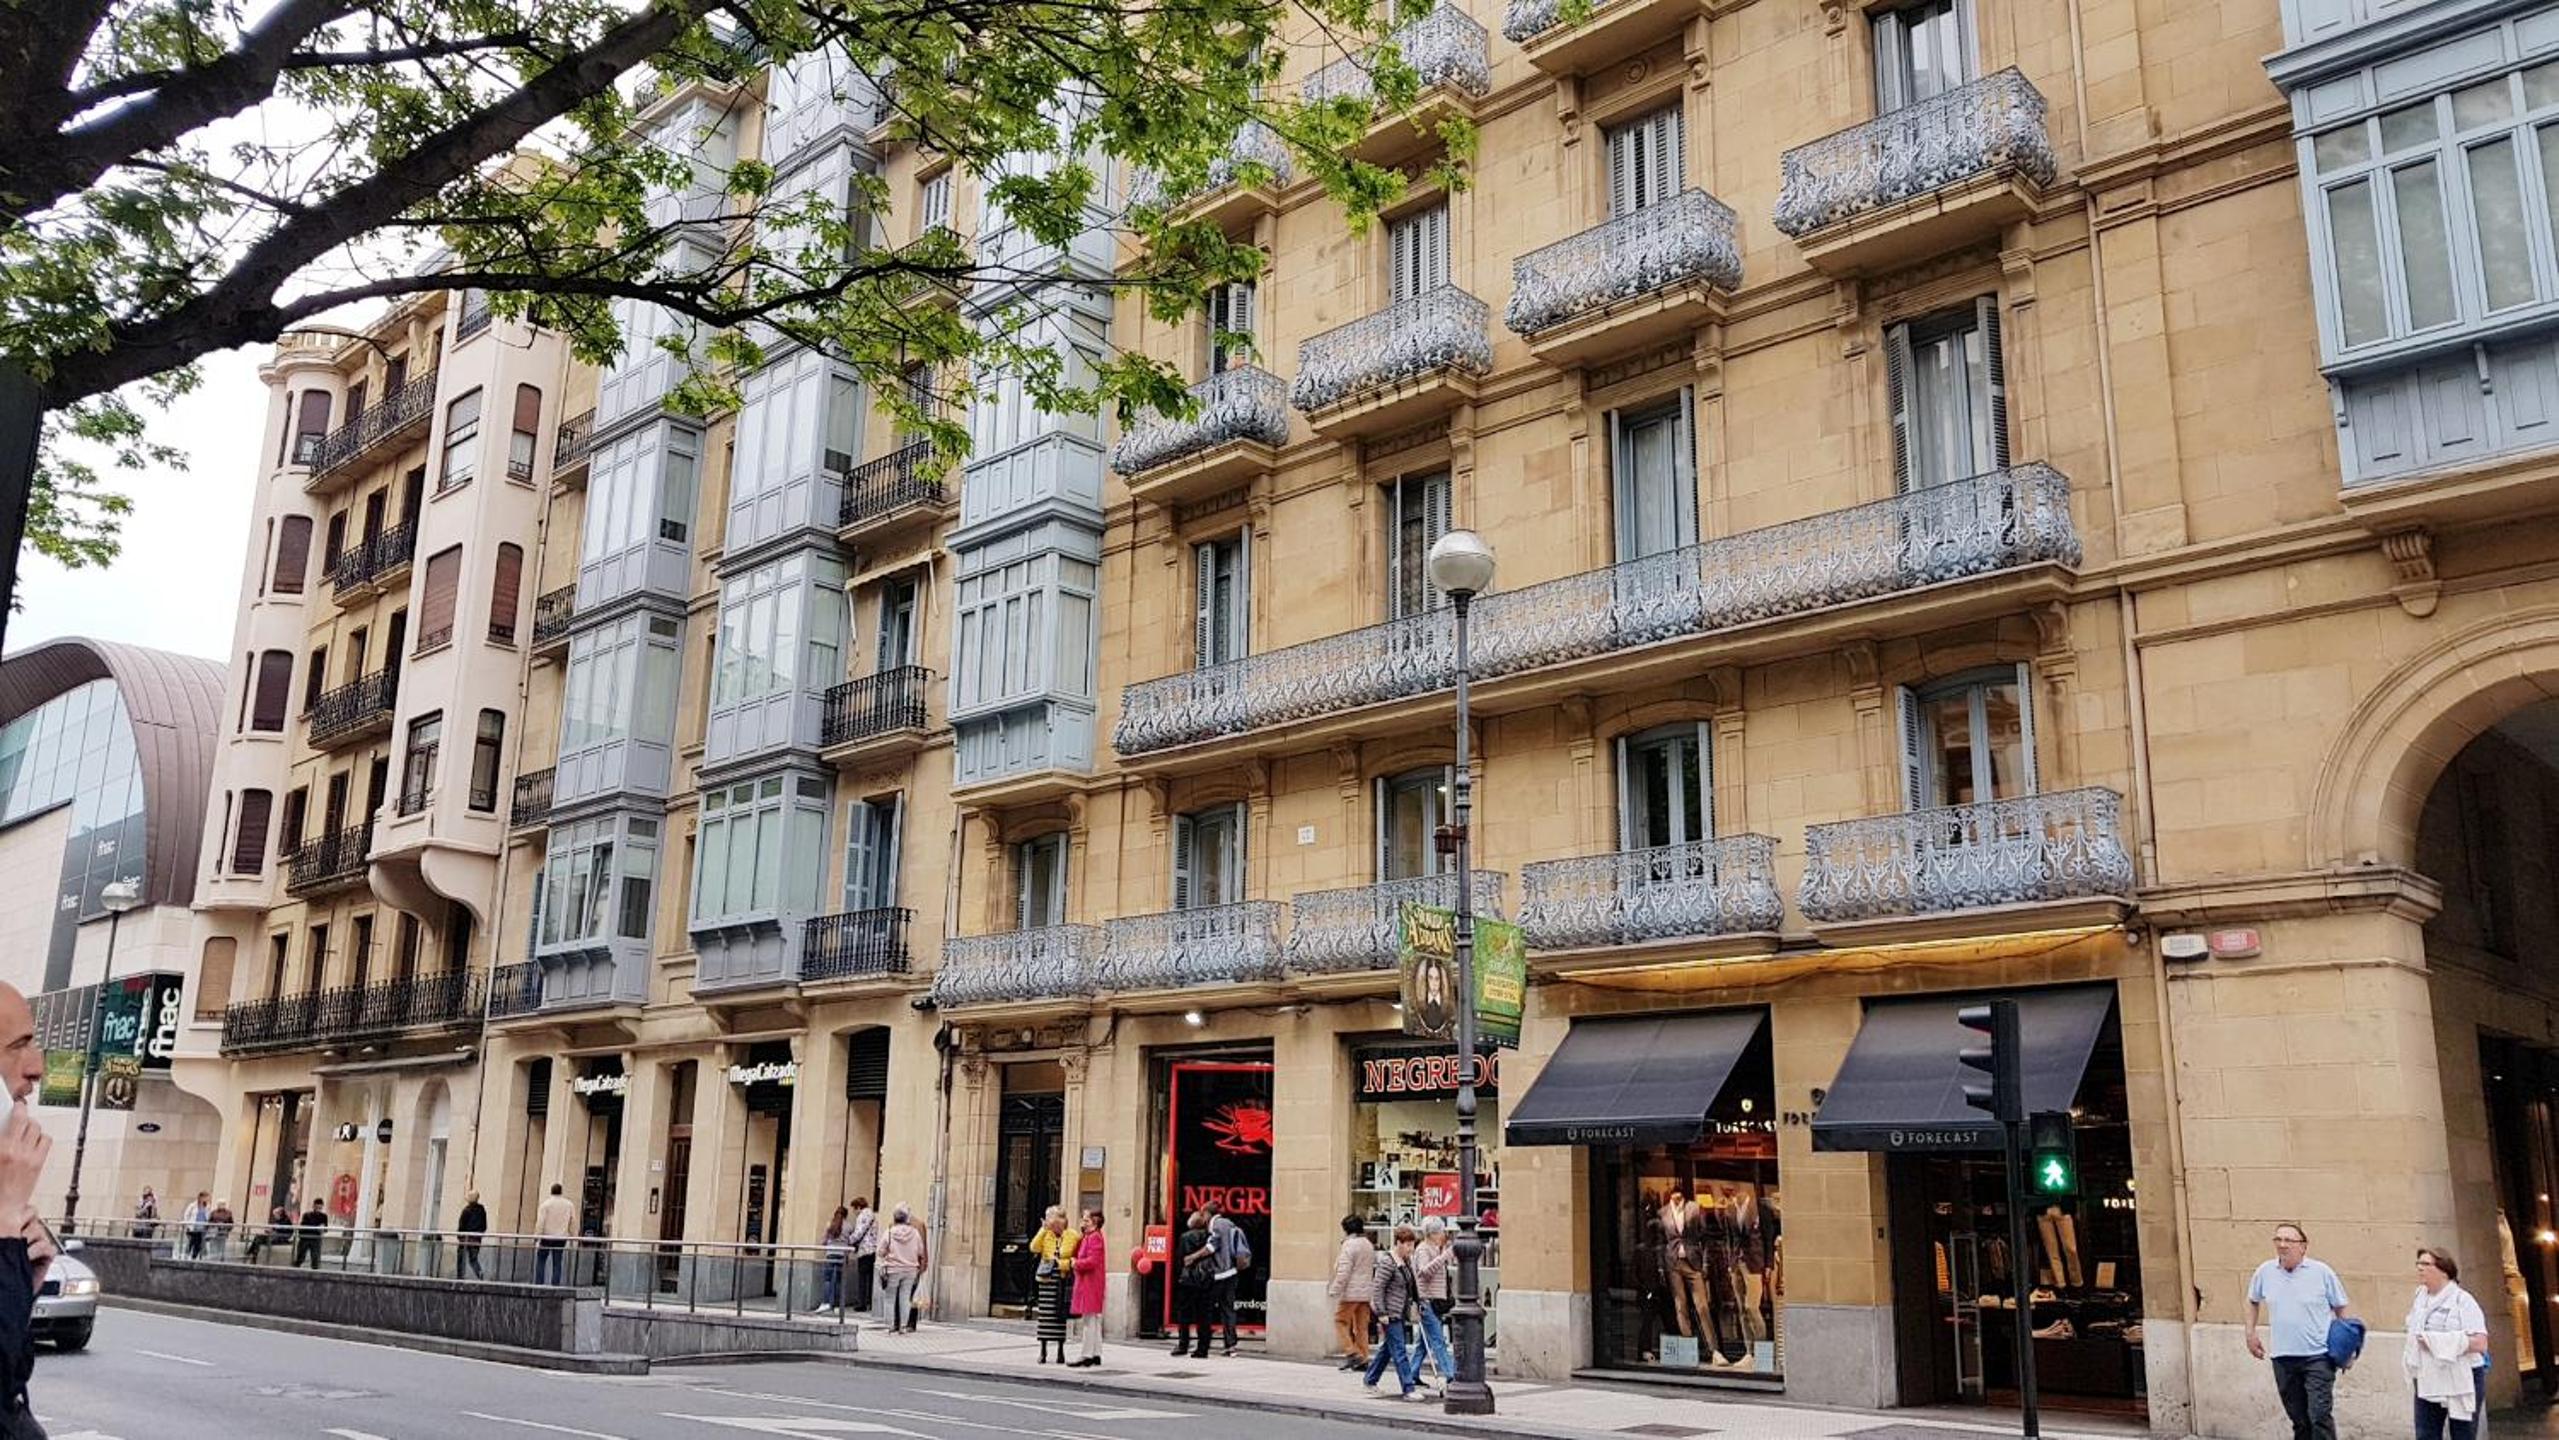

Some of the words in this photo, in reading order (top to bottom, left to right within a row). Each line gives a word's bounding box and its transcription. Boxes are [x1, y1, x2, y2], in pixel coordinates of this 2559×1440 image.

[102, 1011, 136, 1043] fnac
[148, 987, 181, 1059] fnac
[574, 1074, 627, 1096] MegaCalzad
[730, 1061, 798, 1086] MegaCalzado
[1580, 1127, 1636, 1138] FORECAST
[1907, 1131, 1978, 1144] FORECAST
